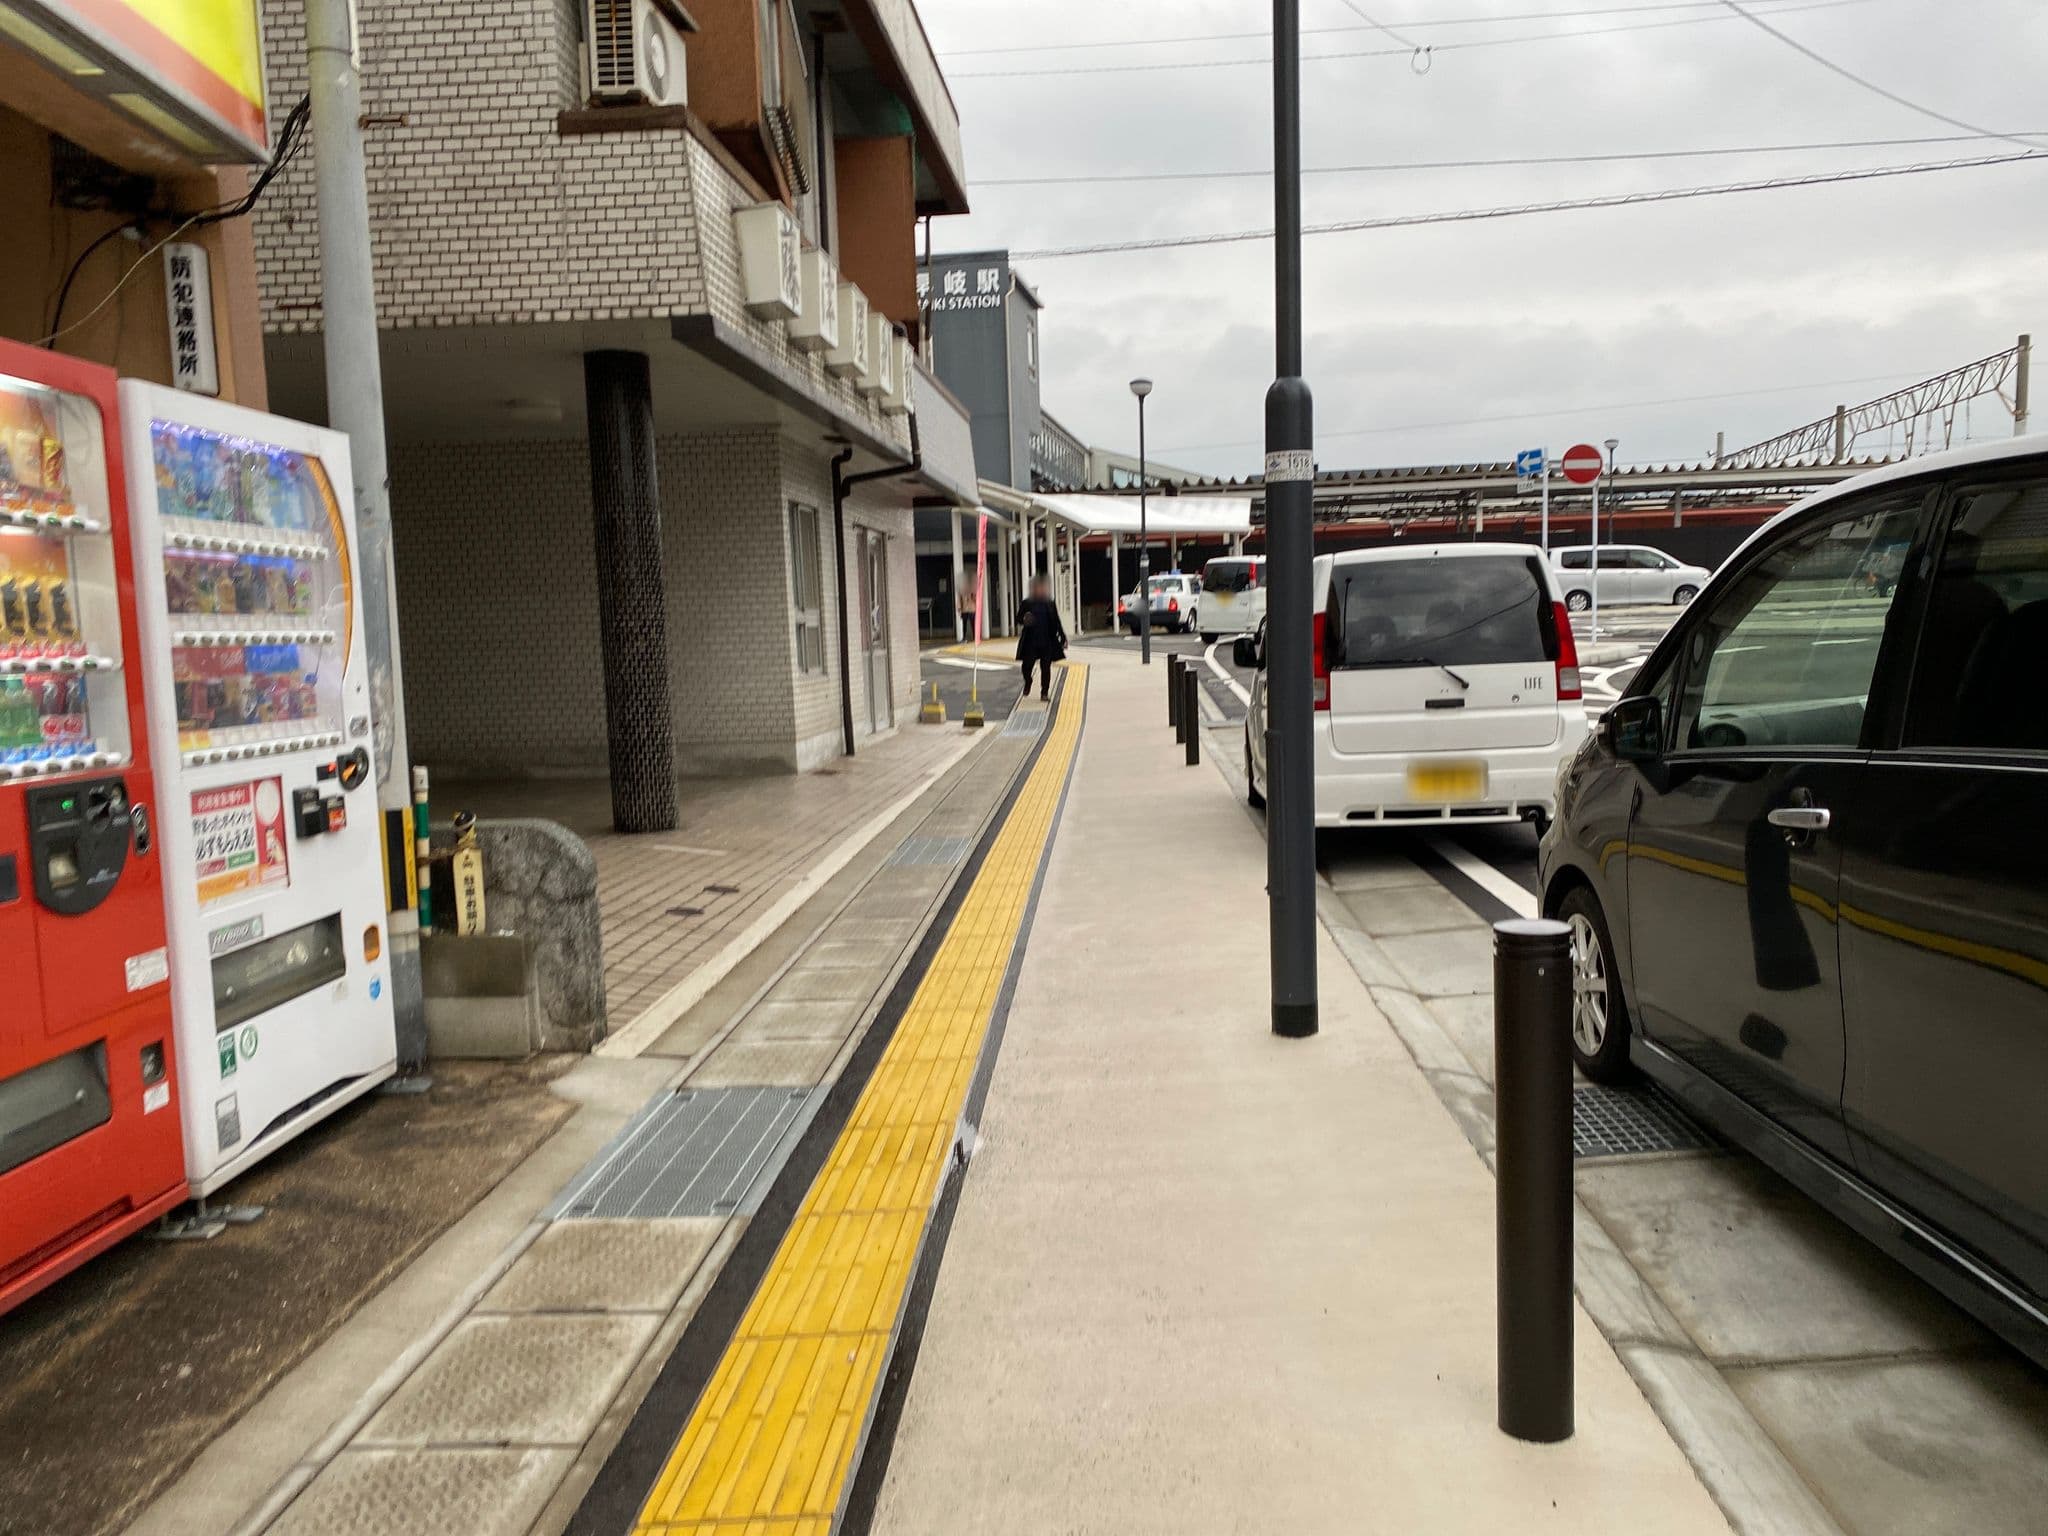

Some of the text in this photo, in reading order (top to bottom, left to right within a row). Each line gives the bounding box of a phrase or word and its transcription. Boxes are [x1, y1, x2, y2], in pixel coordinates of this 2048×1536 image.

[948, 294, 1001, 310] STATION
[170, 256, 198, 376] 防犯連絡所
[1524, 676, 1543, 690] LIFE
